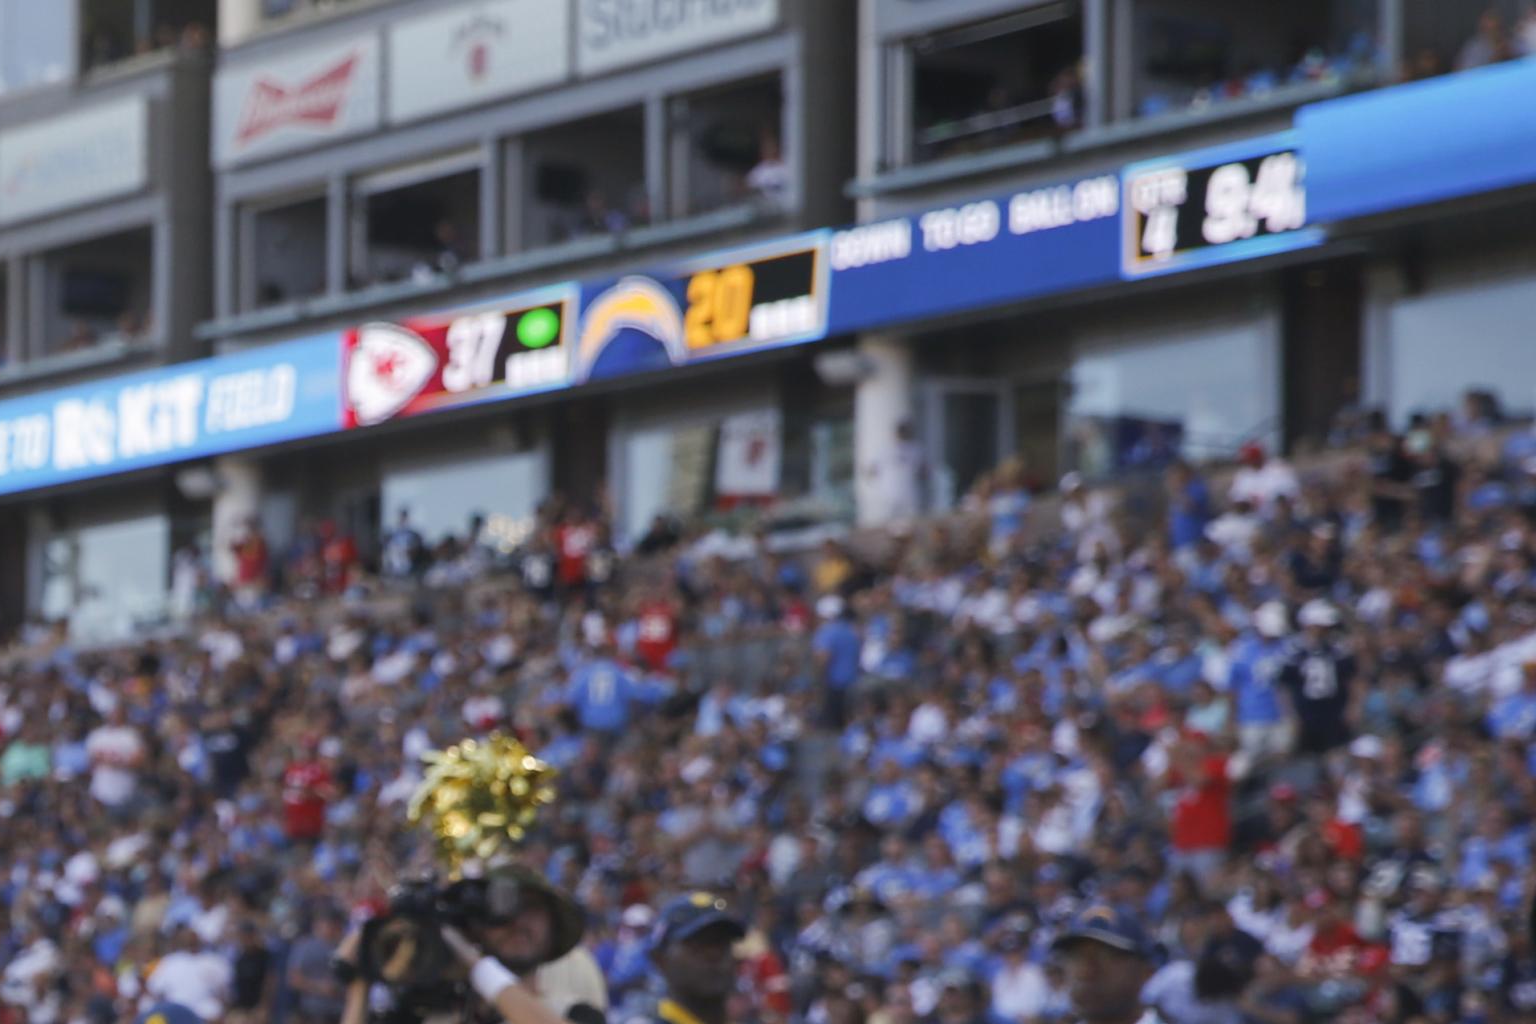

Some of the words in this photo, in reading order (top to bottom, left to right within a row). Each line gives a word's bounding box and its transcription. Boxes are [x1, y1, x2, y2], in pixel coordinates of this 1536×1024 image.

[830, 218, 913, 270] DOWN
[920, 204, 959, 253] TO
[957, 198, 1001, 246] GO
[1009, 180, 1073, 235] BALL
[1072, 174, 1120, 223] ON
[684, 264, 755, 350] 20
[441, 312, 508, 394] 37
[10, 411, 50, 470] TO
[205, 362, 297, 433] FIELD
